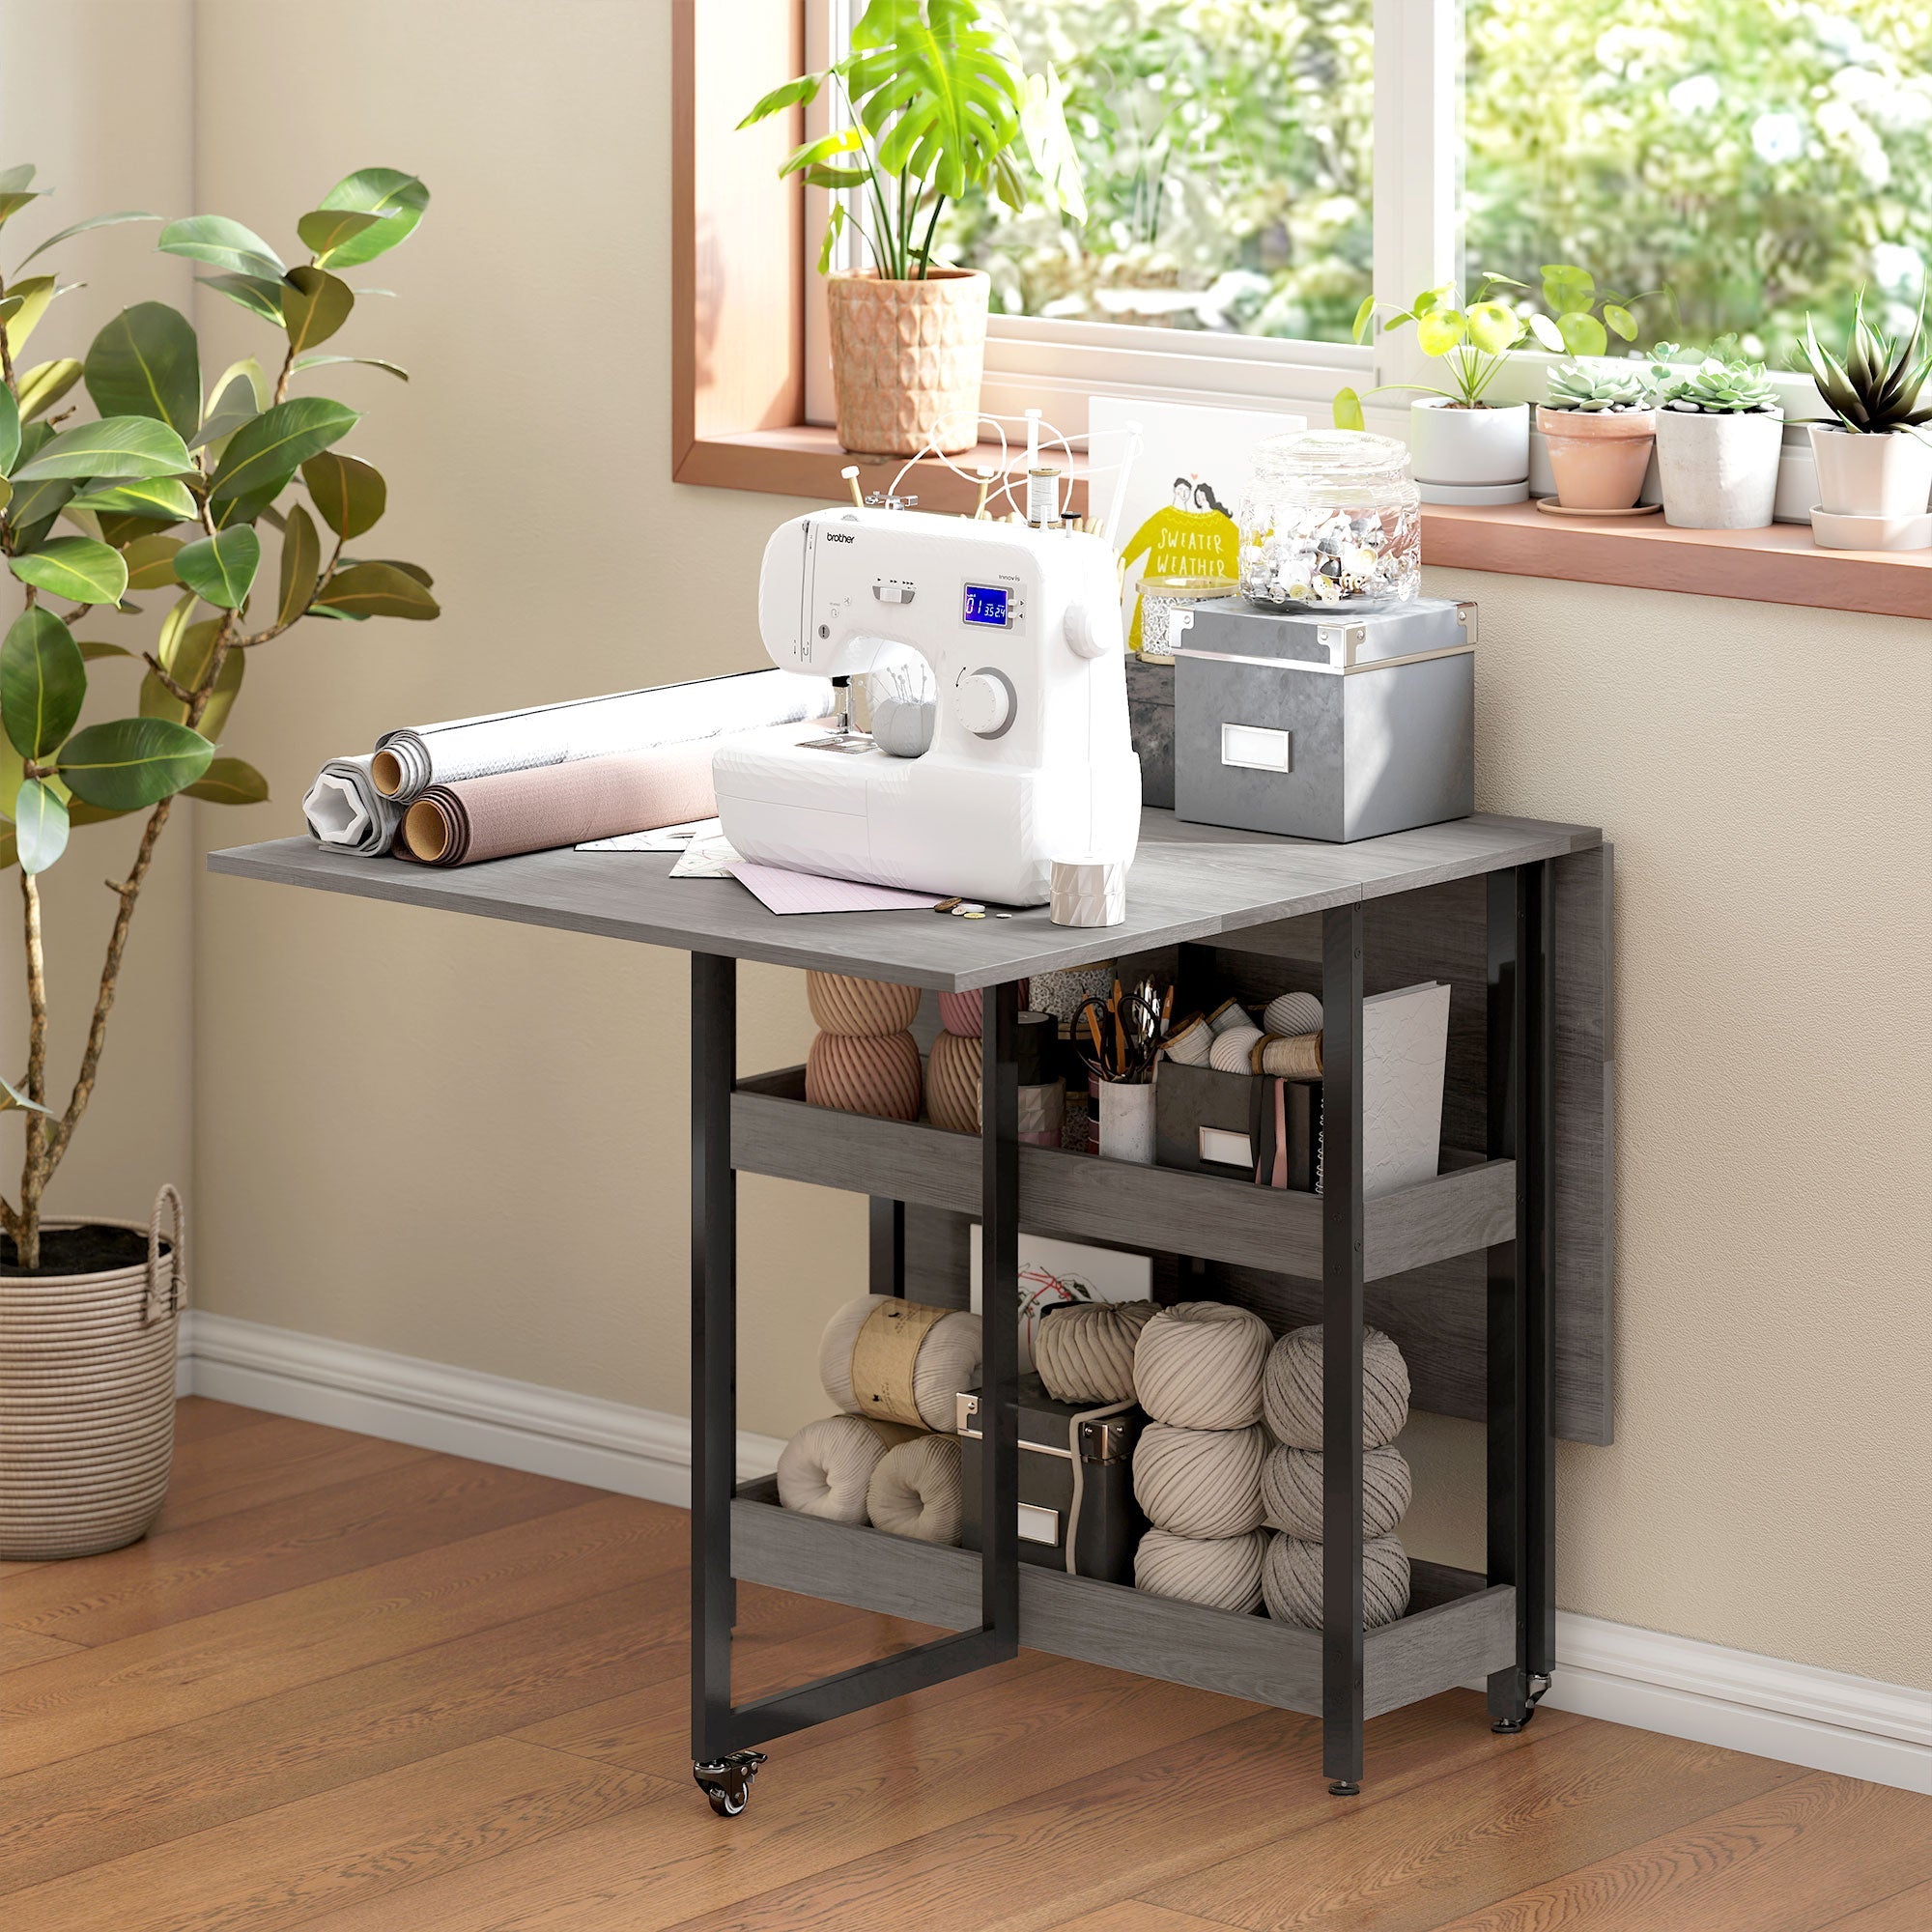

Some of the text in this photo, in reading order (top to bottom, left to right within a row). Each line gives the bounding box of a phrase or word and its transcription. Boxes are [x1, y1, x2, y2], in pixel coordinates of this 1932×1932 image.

[827, 532, 855, 544] brother
[1157, 527, 1224, 554] SWEATER
[1157, 554, 1228, 578] WEATHER
